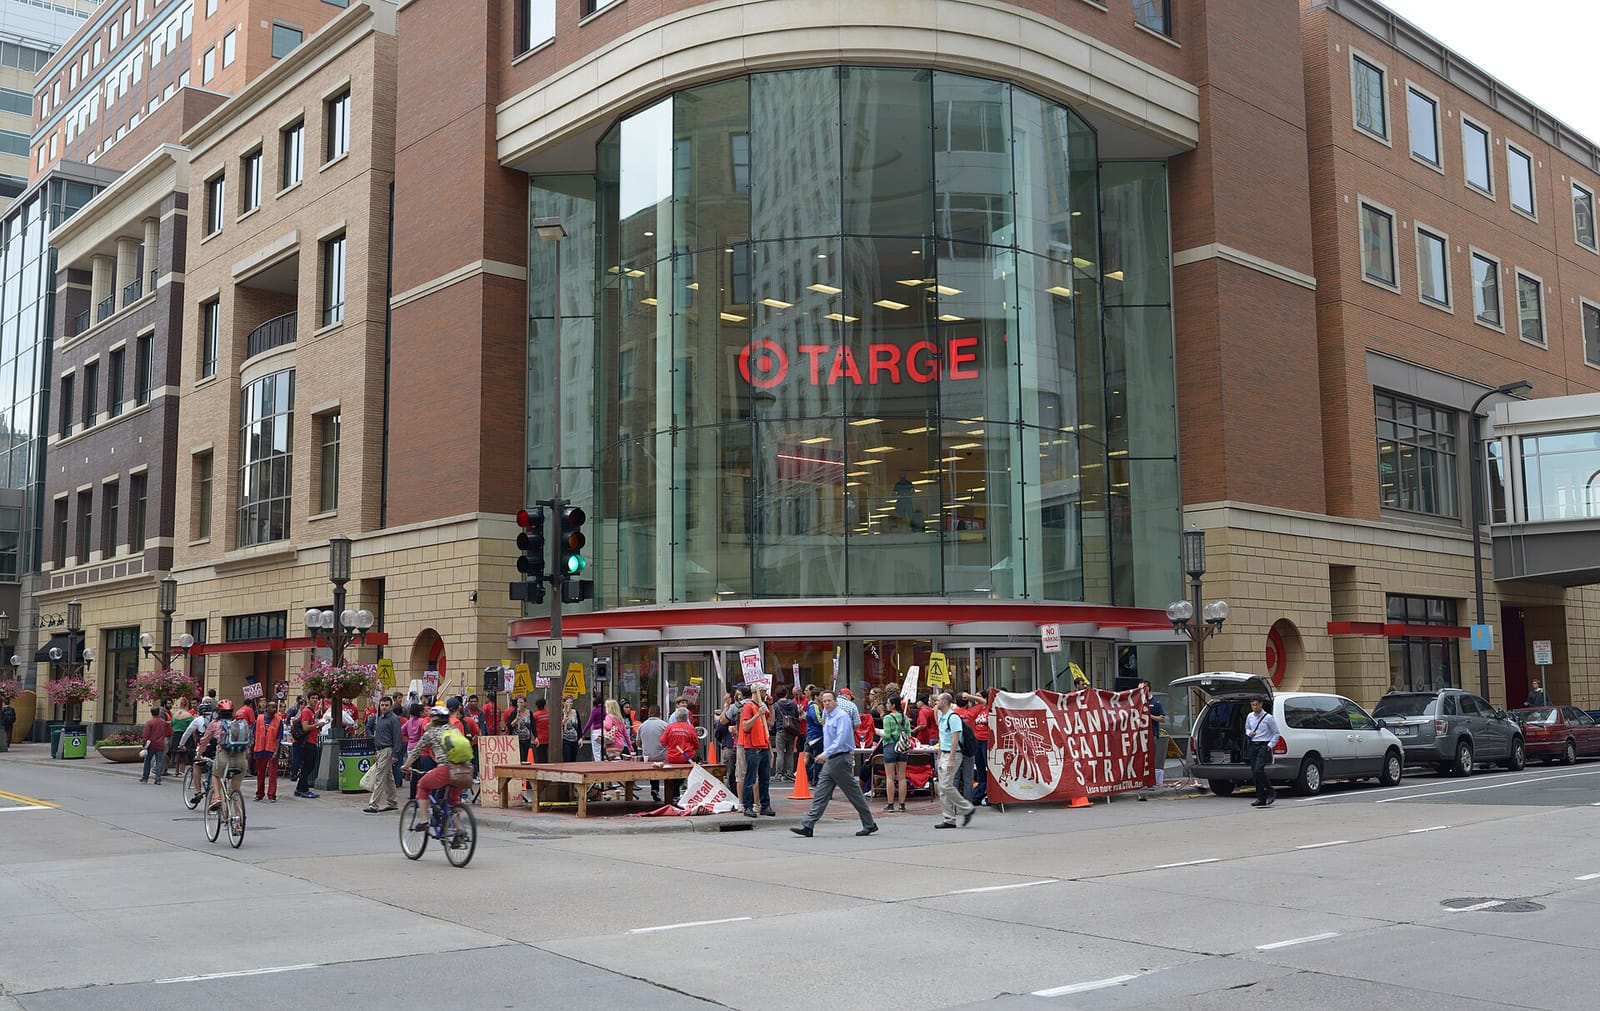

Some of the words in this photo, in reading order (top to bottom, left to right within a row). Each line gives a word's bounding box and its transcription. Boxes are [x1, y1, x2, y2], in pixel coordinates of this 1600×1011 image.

[798, 335, 1007, 386] TARGE
[1045, 628, 1055, 636] NO
[545, 645, 557, 657] NO
[541, 661, 561, 672] TURNS
[1004, 715, 1039, 729] STRIKE!
[1063, 708, 1150, 735] JANITORS
[479, 736, 516, 752] HONK
[1067, 733, 1112, 759] CALL
[485, 752, 509, 765] FOR
[1074, 754, 1150, 786] STRIKE
